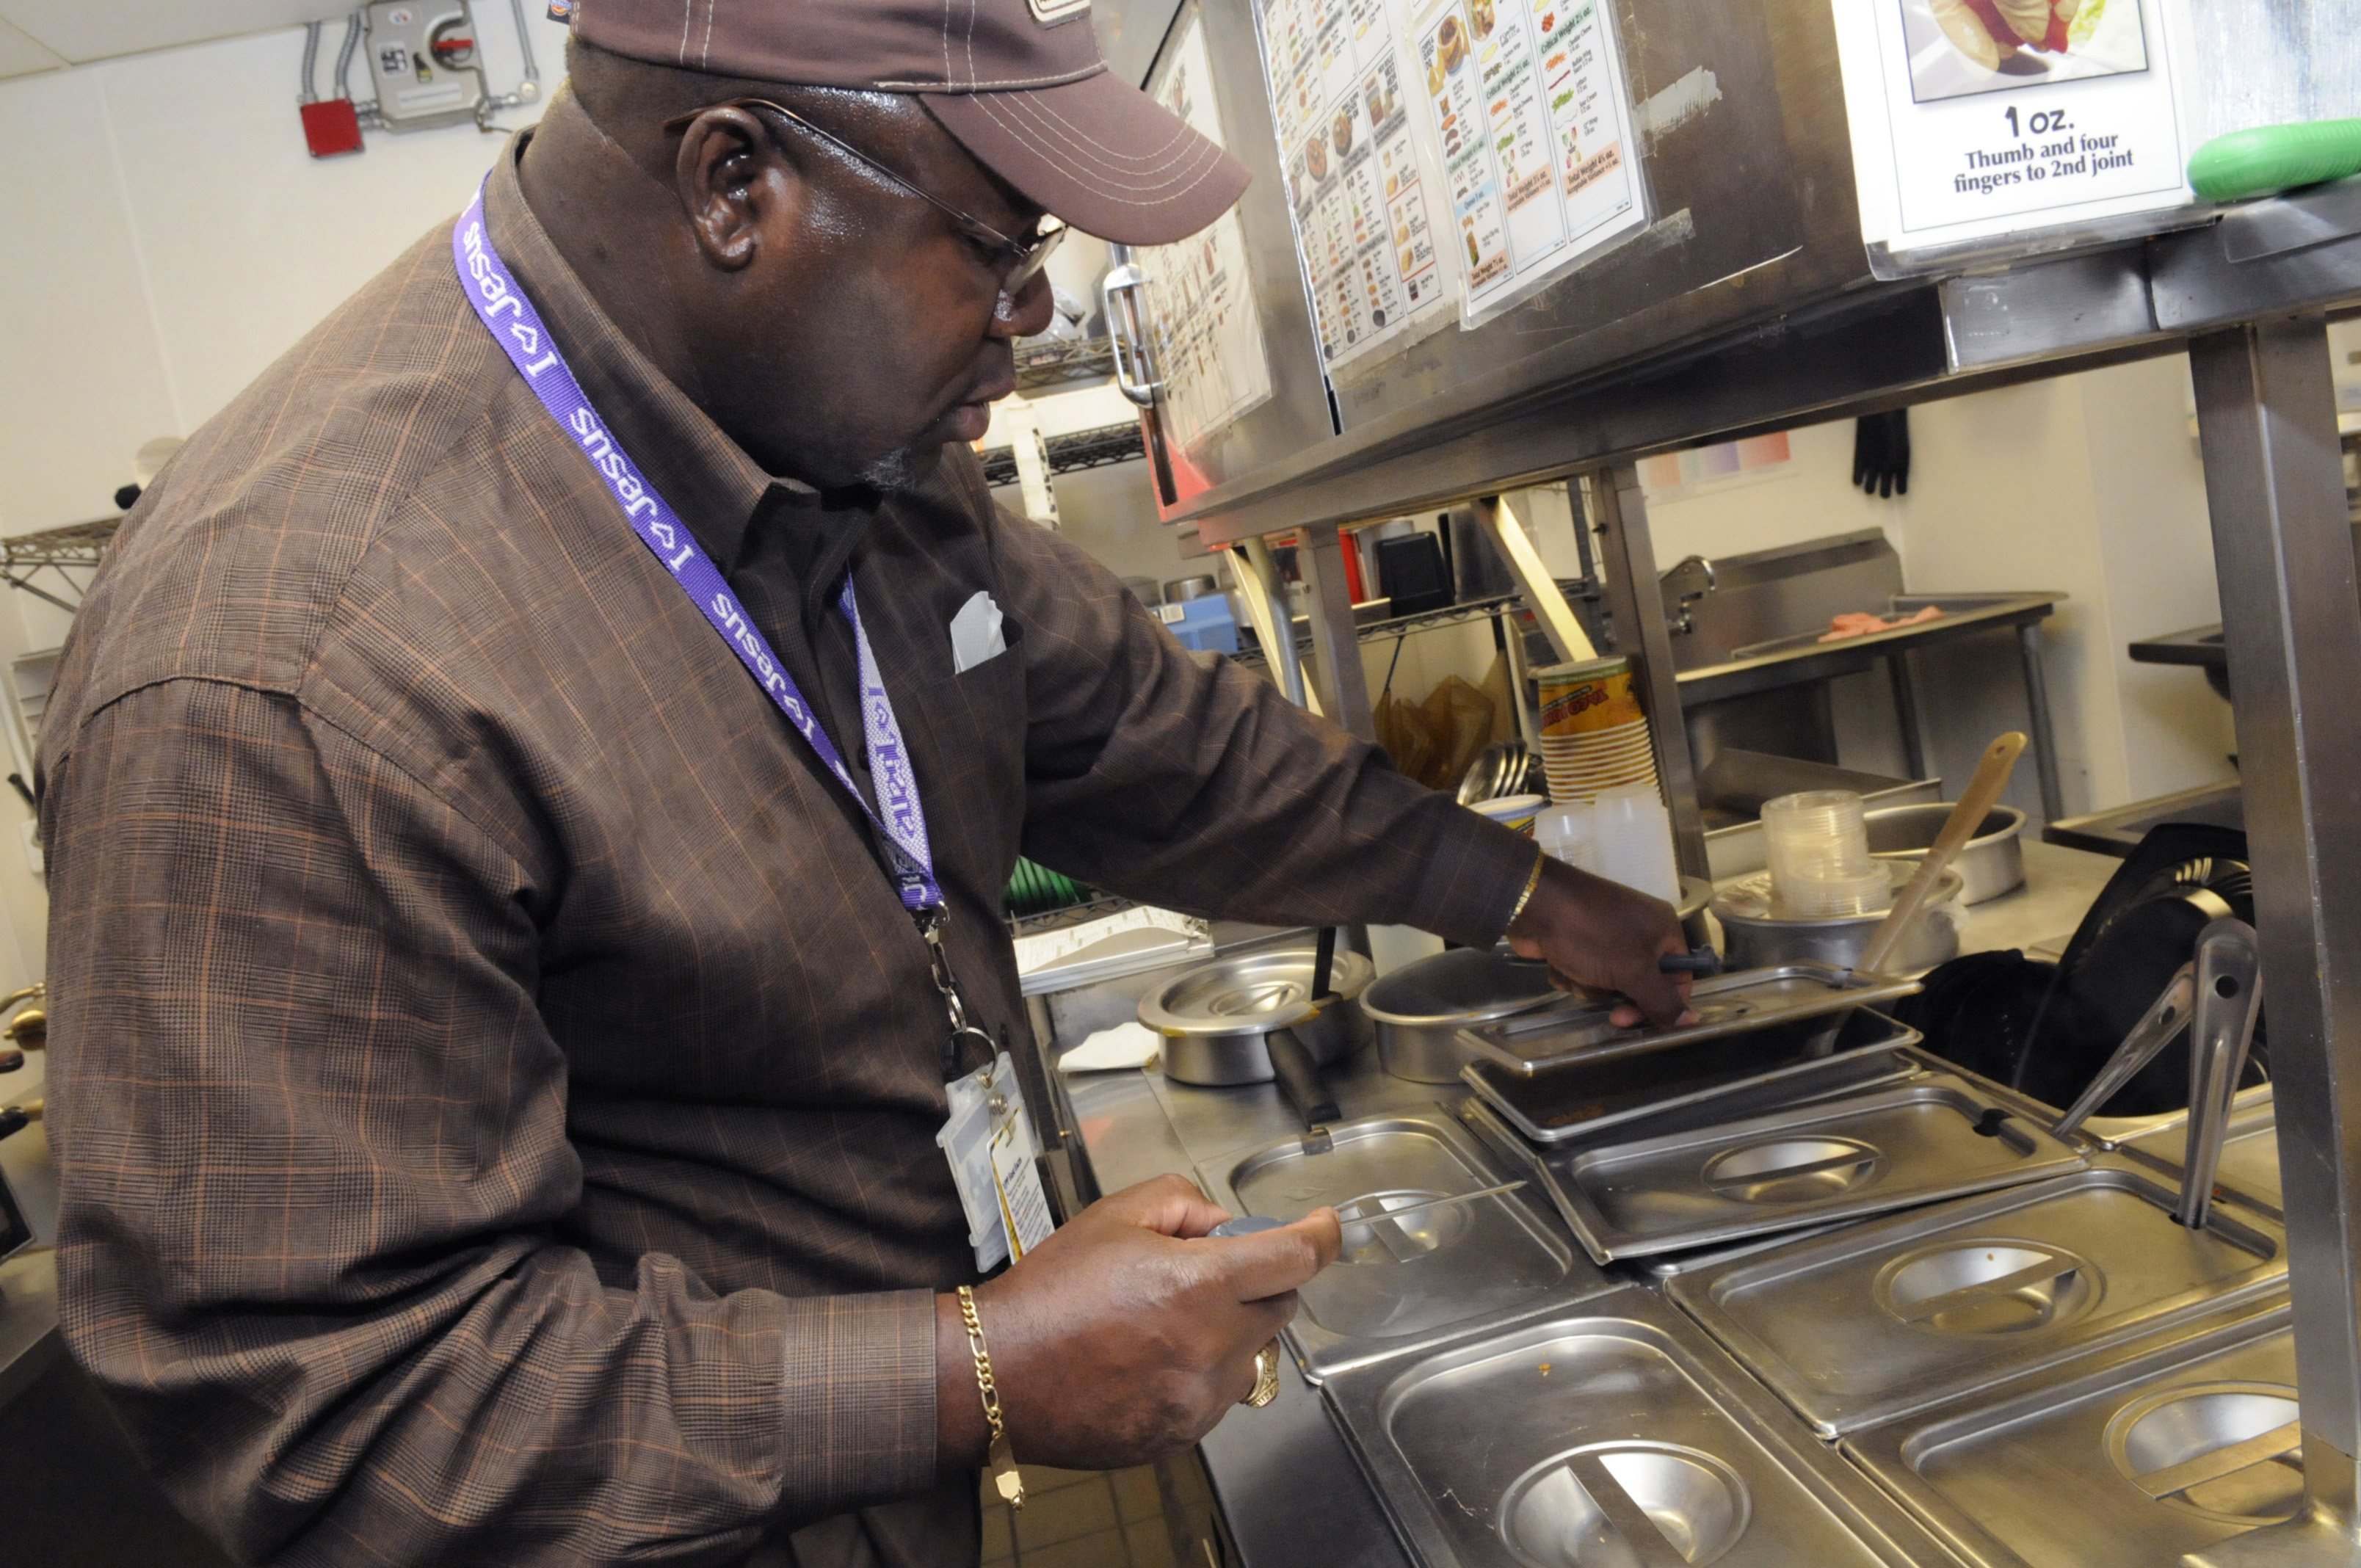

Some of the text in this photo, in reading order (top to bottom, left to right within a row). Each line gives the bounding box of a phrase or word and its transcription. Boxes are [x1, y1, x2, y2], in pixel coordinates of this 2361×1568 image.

[1540, 35, 1558, 54] Critical
[1558, 20, 1575, 38] Weight
[1583, 6, 1591, 16] oz.
[1486, 84, 1501, 99] Critical
[1500, 70, 1516, 86] Weight
[2005, 106, 2075, 138] 1 oz.
[1567, 172, 1580, 184] Total
[1580, 160, 1597, 175] Weight
[1606, 150, 1614, 159] oz.
[1965, 134, 2119, 170] Thumb and four
[1567, 179, 1587, 193] Acceptable
[1587, 167, 1604, 181] Variance
[1954, 149, 2135, 195] fingers to 2nd joint
[1507, 190, 1517, 200] Total
[1517, 180, 1533, 193] Weight
[1471, 270, 1480, 280] Total
[1480, 264, 1493, 275] Weight
[463, 221, 558, 377] I Jesus
[570, 407, 694, 571] I Jesus
[711, 593, 814, 739] I Jesus
